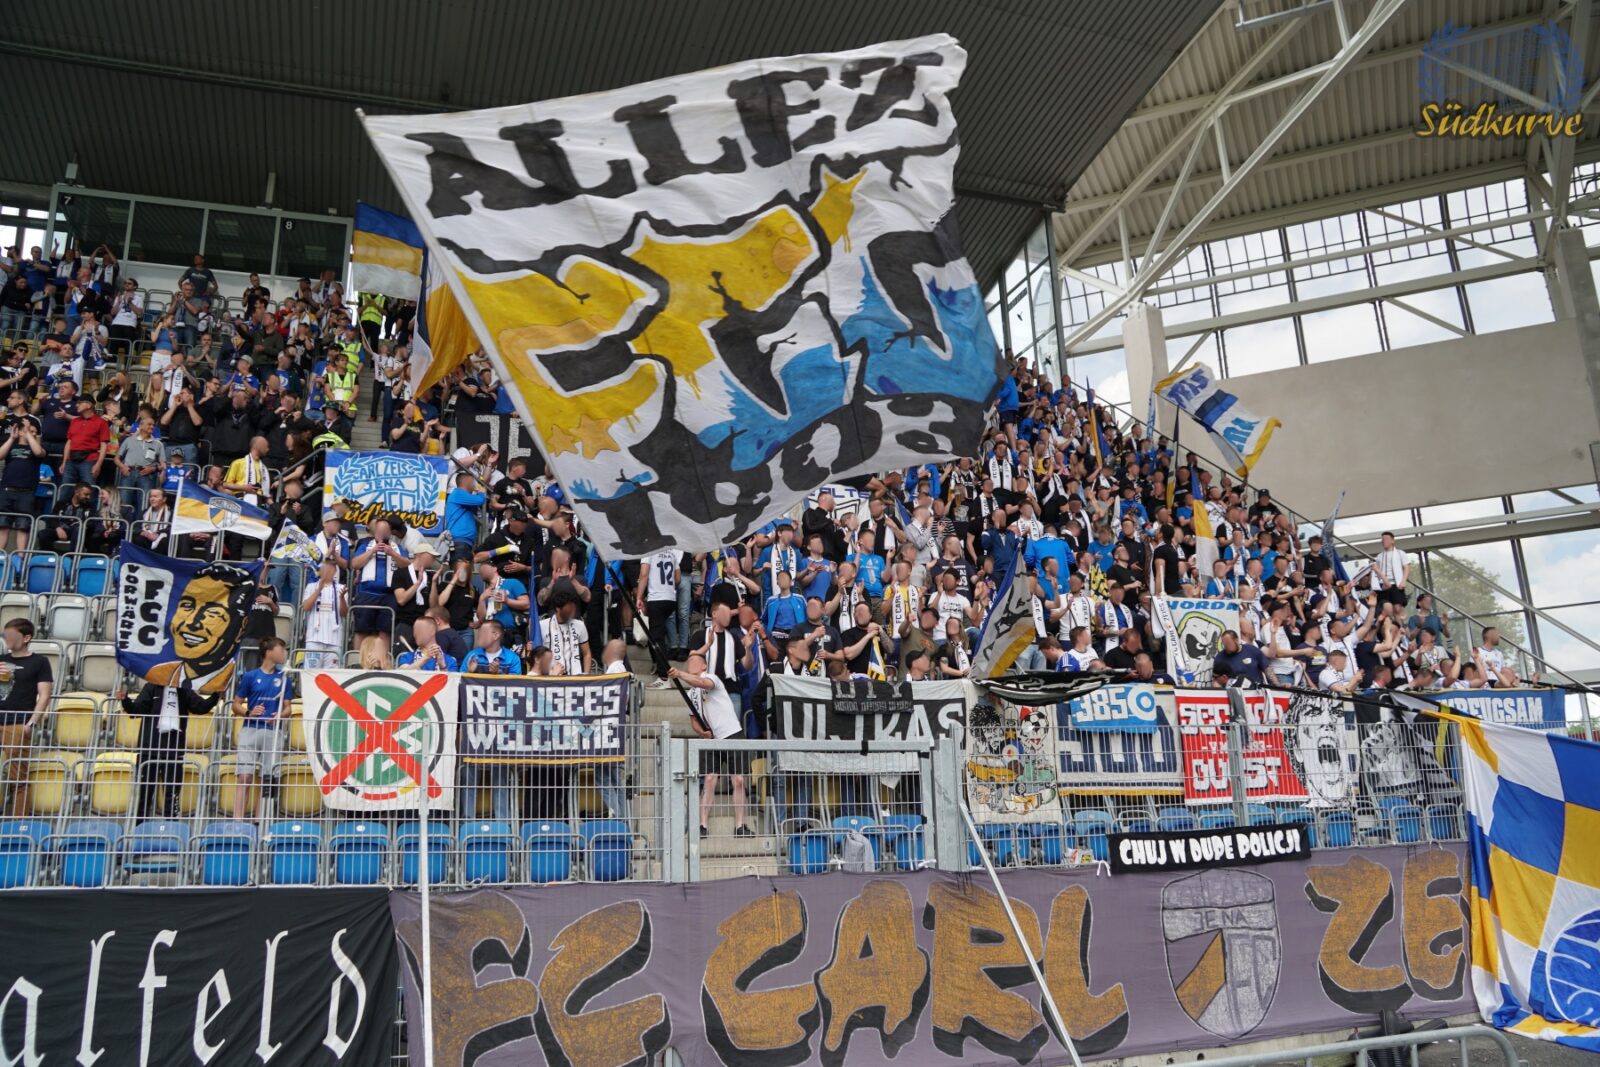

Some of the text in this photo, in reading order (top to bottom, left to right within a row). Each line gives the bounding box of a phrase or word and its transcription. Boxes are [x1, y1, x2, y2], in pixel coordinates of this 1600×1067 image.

[405, 50, 944, 218] ALLEZ
[63, 195, 72, 205] 7
[285, 220, 293, 231] 8
[363, 479, 405, 492] JENA
[657, 560, 674, 586] 12
[466, 684, 621, 717] REFUGEES
[467, 717, 620, 750] WELCOME
[1193, 758, 1281, 791] OUST
[1119, 839, 1167, 865] CHUJ
[1169, 838, 1186, 863] W
[1189, 835, 1234, 863] DUPE
[701, 878, 1131, 1067] CARL
